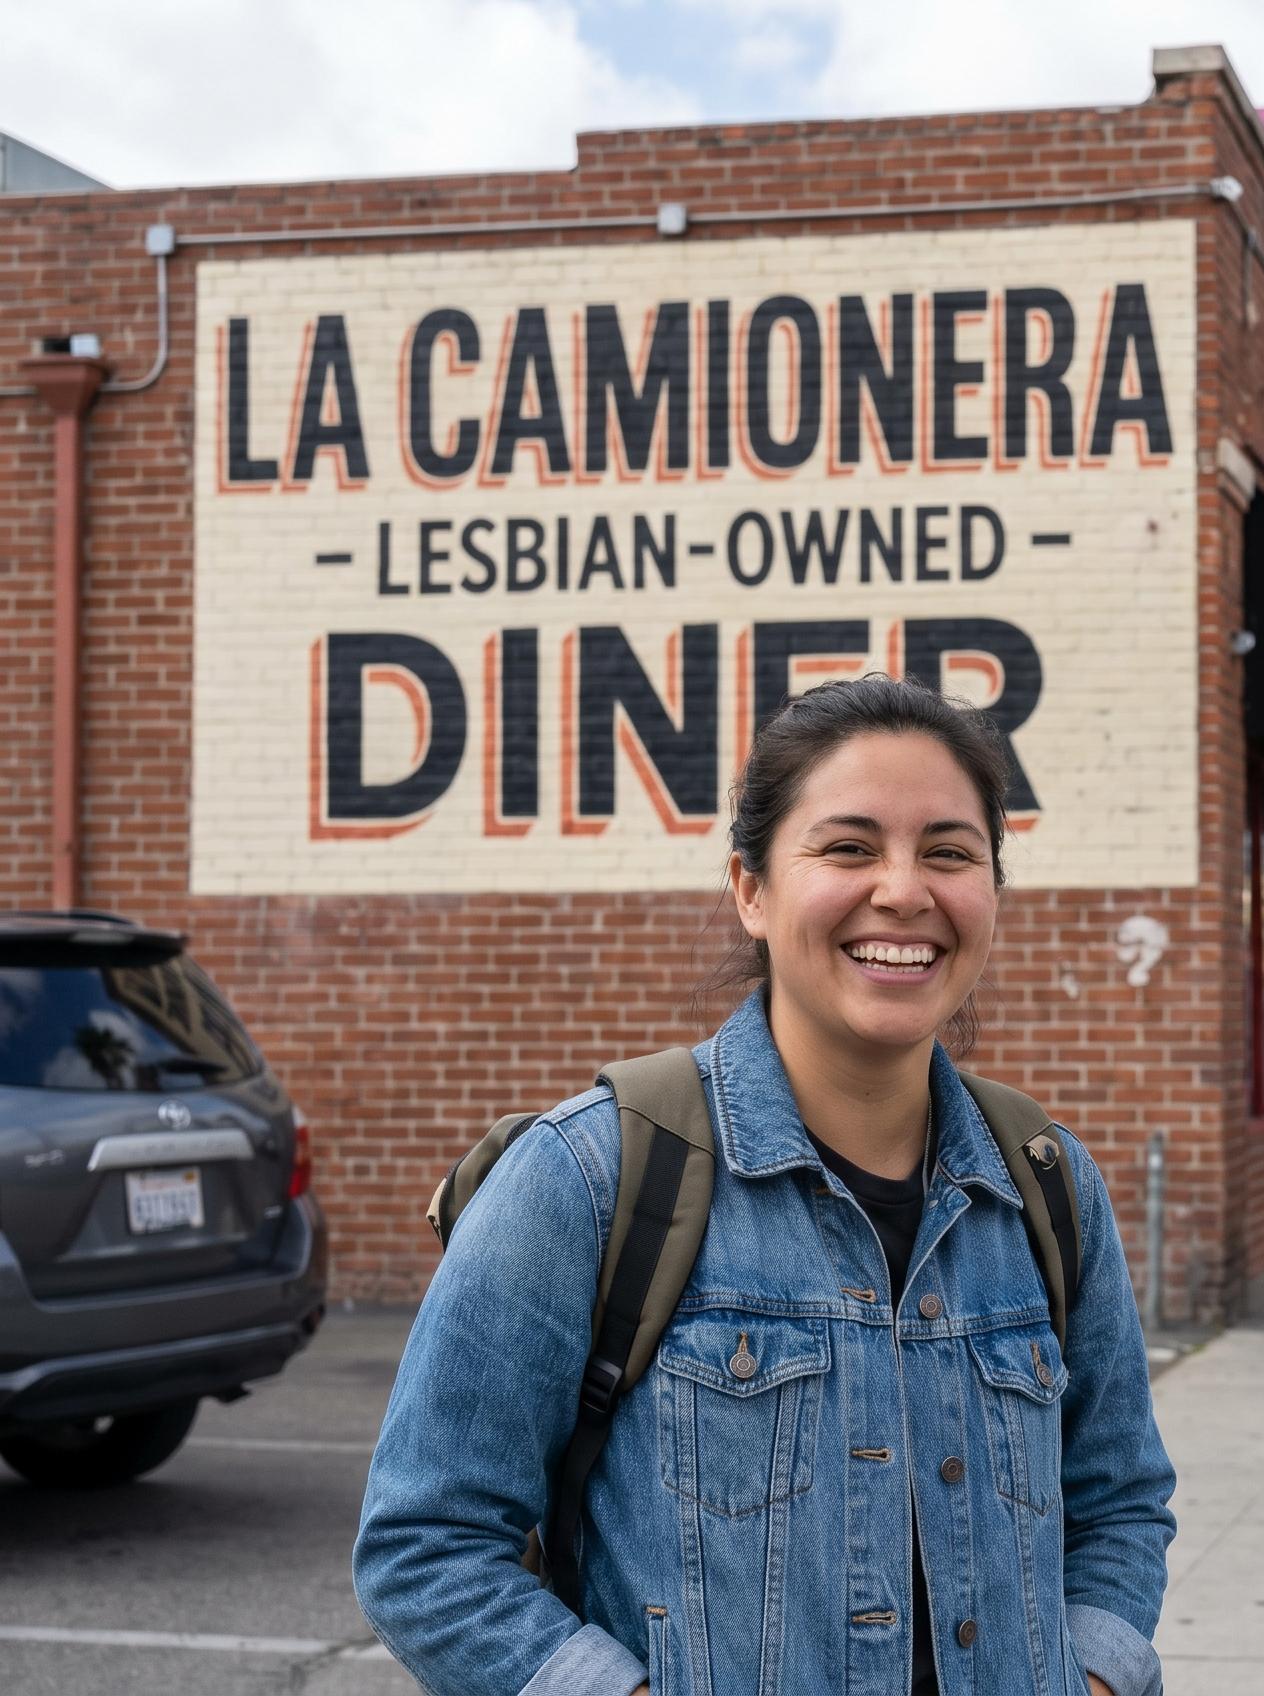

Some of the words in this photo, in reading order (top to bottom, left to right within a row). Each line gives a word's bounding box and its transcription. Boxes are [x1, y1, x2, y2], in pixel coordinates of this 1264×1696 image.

[217, 316, 370, 494] LA
[400, 283, 1173, 489] CAMIONERA
[378, 505, 1005, 595] LESBIAN-OWNED
